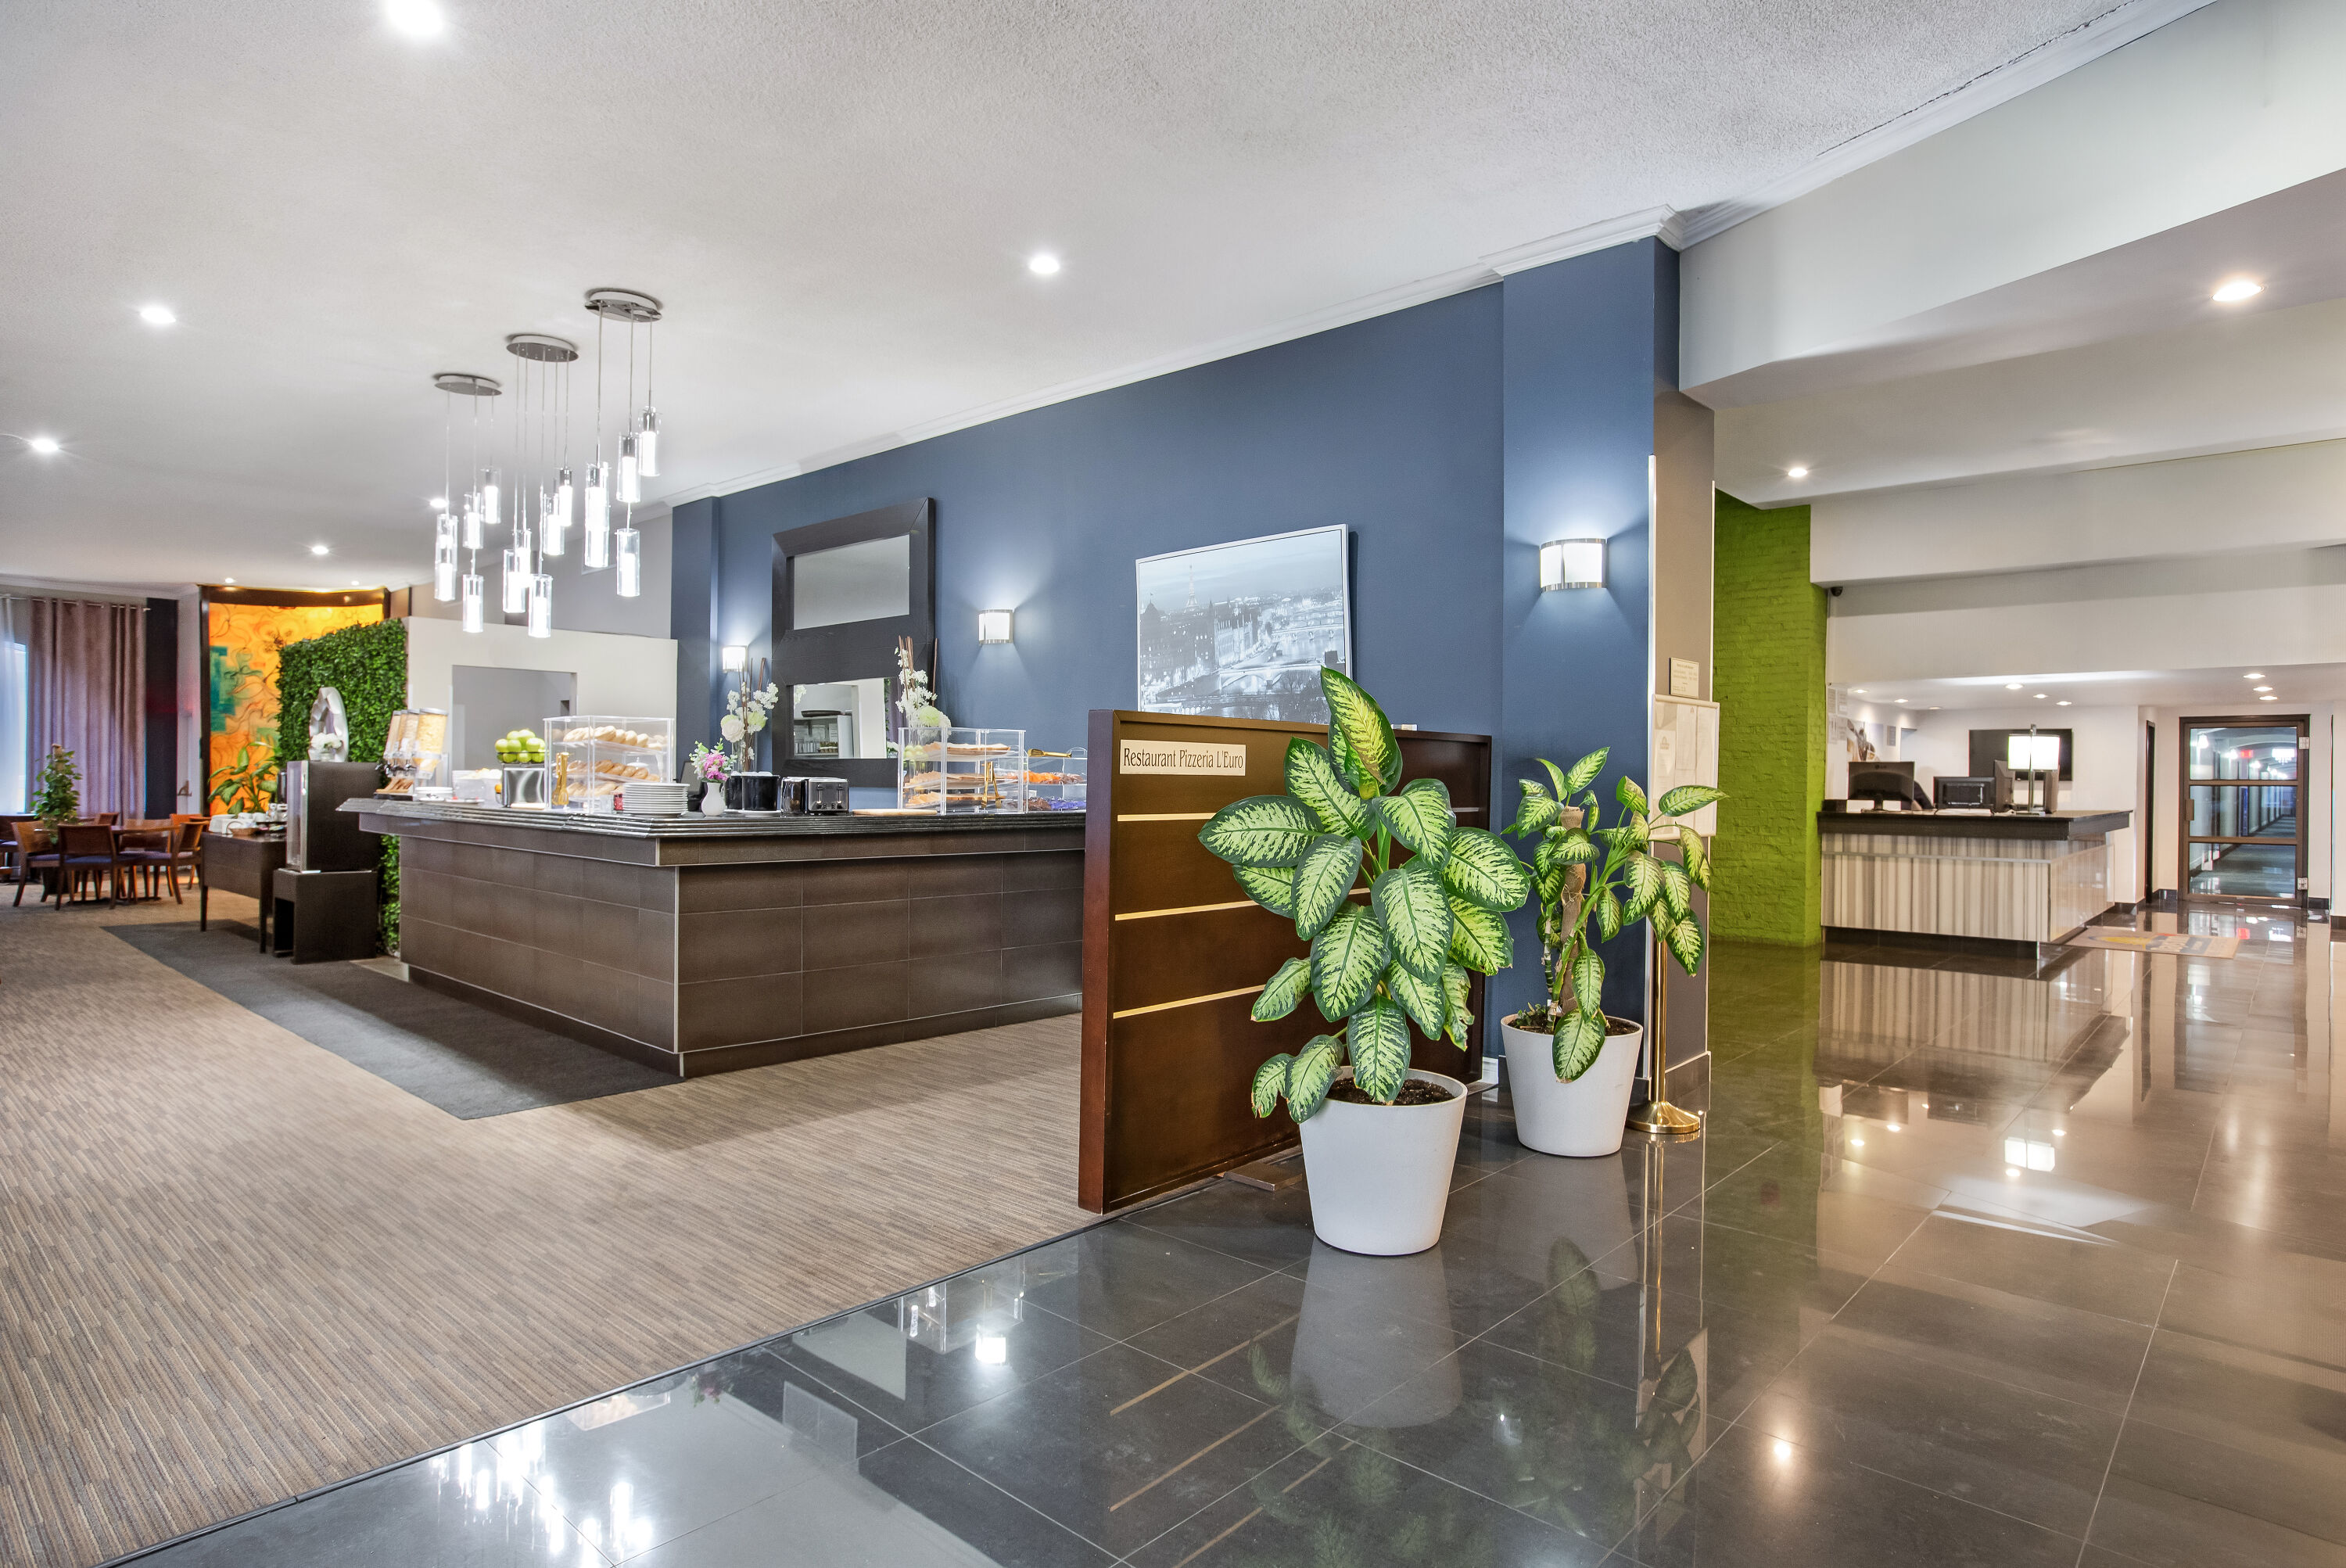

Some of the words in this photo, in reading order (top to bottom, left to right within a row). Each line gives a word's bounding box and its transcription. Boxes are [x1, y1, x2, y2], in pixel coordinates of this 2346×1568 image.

[1124, 748, 1176, 767] Restaurant
[1179, 749, 1214, 768] Pizzeria
[1217, 751, 1243, 769] L'Euro
